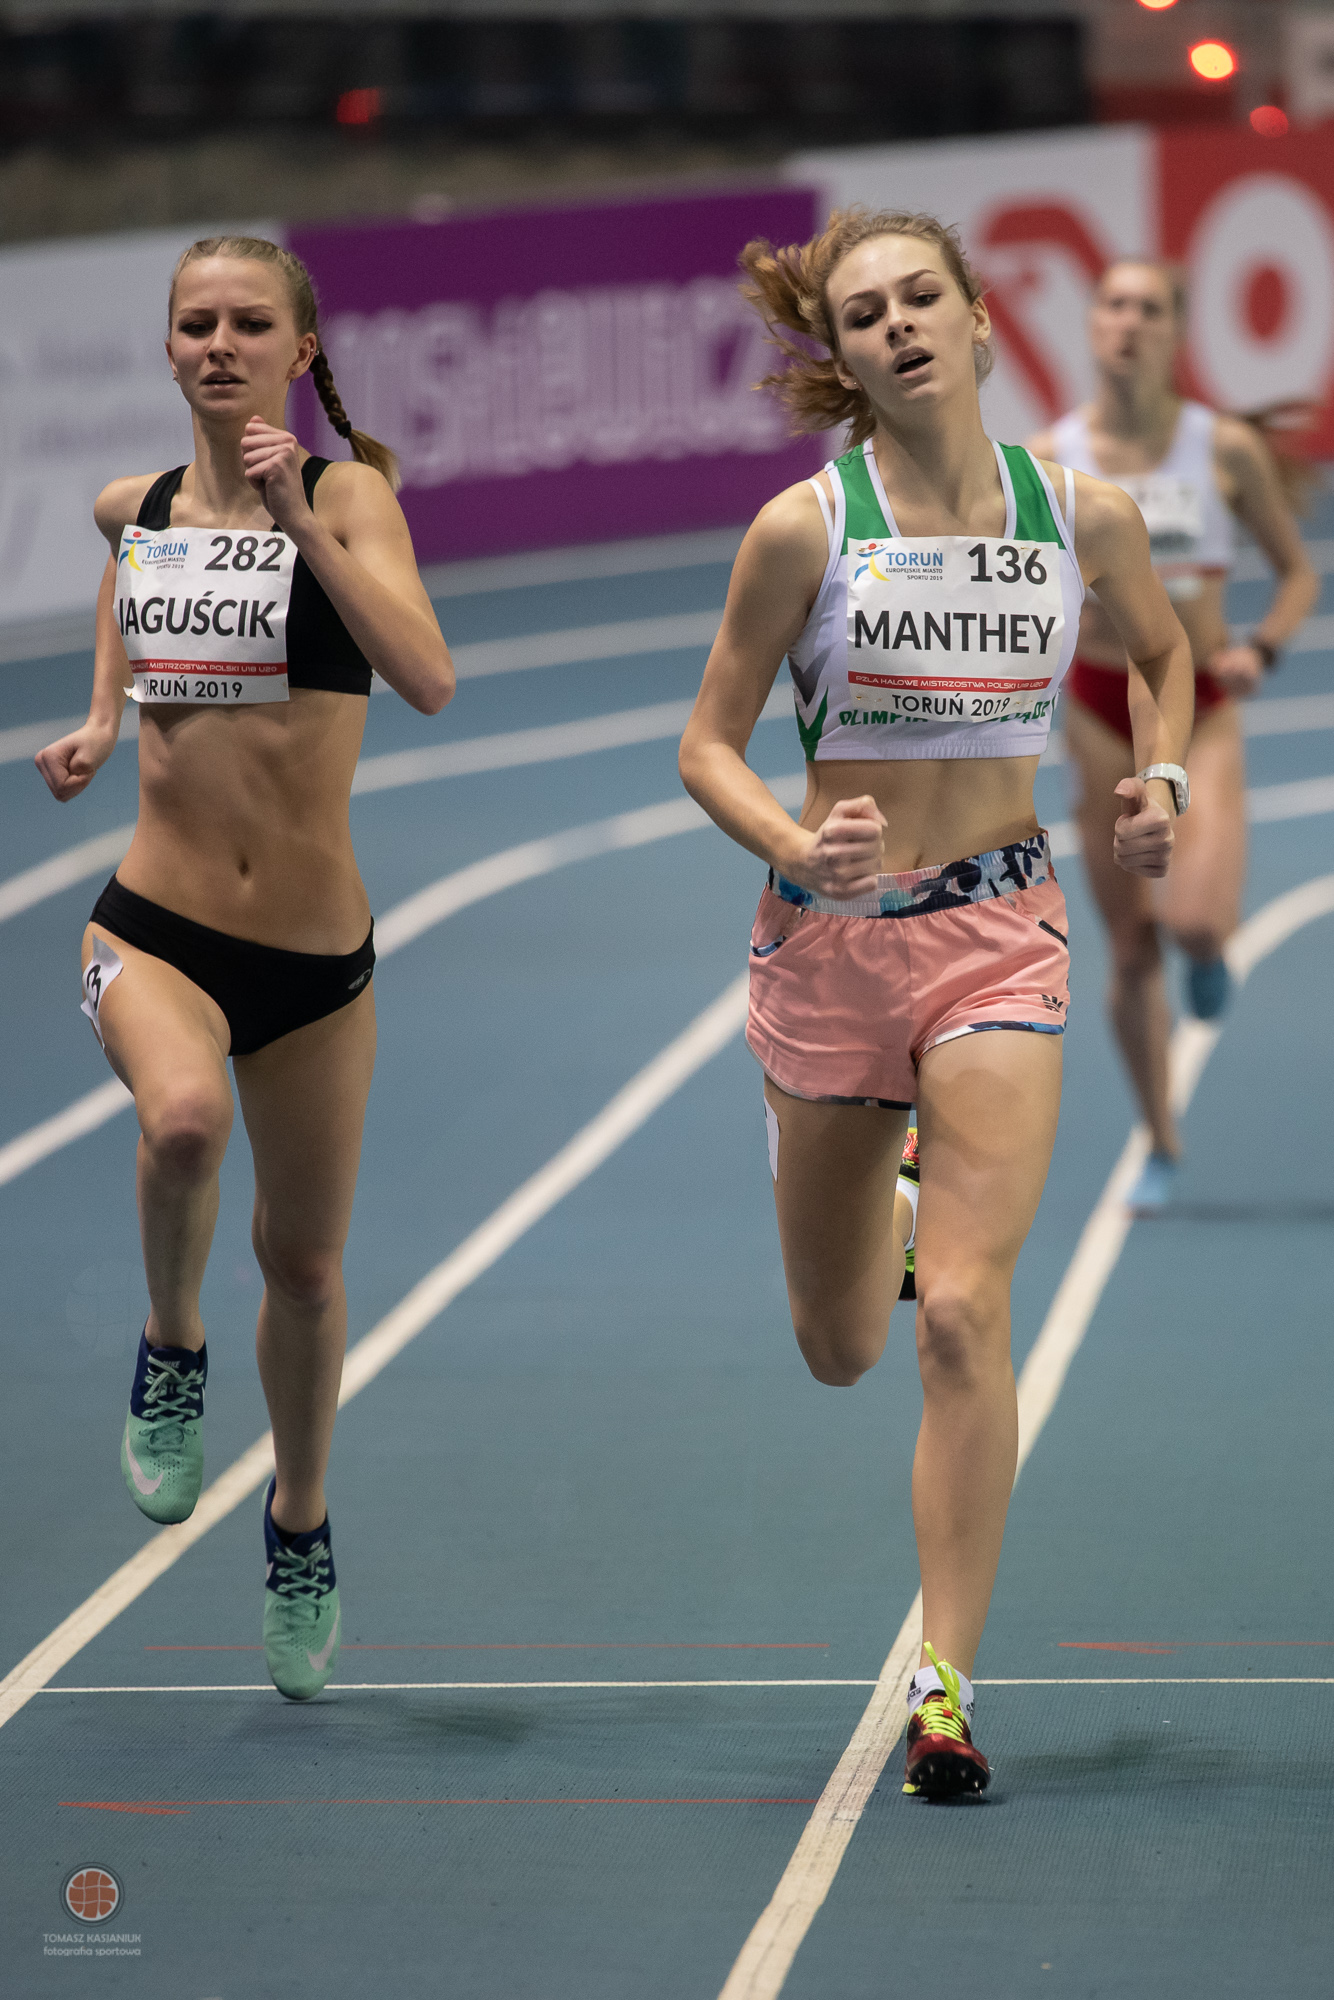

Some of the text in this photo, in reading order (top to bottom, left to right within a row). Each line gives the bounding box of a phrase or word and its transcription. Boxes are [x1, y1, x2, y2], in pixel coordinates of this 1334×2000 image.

[147, 538, 189, 559] TORUŃ
[204, 535, 286, 572] 282
[885, 547, 943, 566] TORUŃ
[967, 542, 1048, 585] 136
[853, 609, 1057, 655] MANTHEY
[149, 662, 208, 671] MISTRZOSTWA
[209, 664, 240, 672] POLSKI
[241, 665, 257, 673] U18
[258, 665, 278, 673] U20
[143, 675, 243, 698] RUŃ 2019
[855, 675, 880, 684] PZLA
[880, 678, 919, 687] HALOWE
[920, 680, 986, 689] MISTRZOSTWA
[987, 682, 1016, 690] POLSKI
[891, 693, 964, 716] TORUŃ
[970, 697, 1011, 717] 2019
[838, 709, 929, 726] OLIMP
